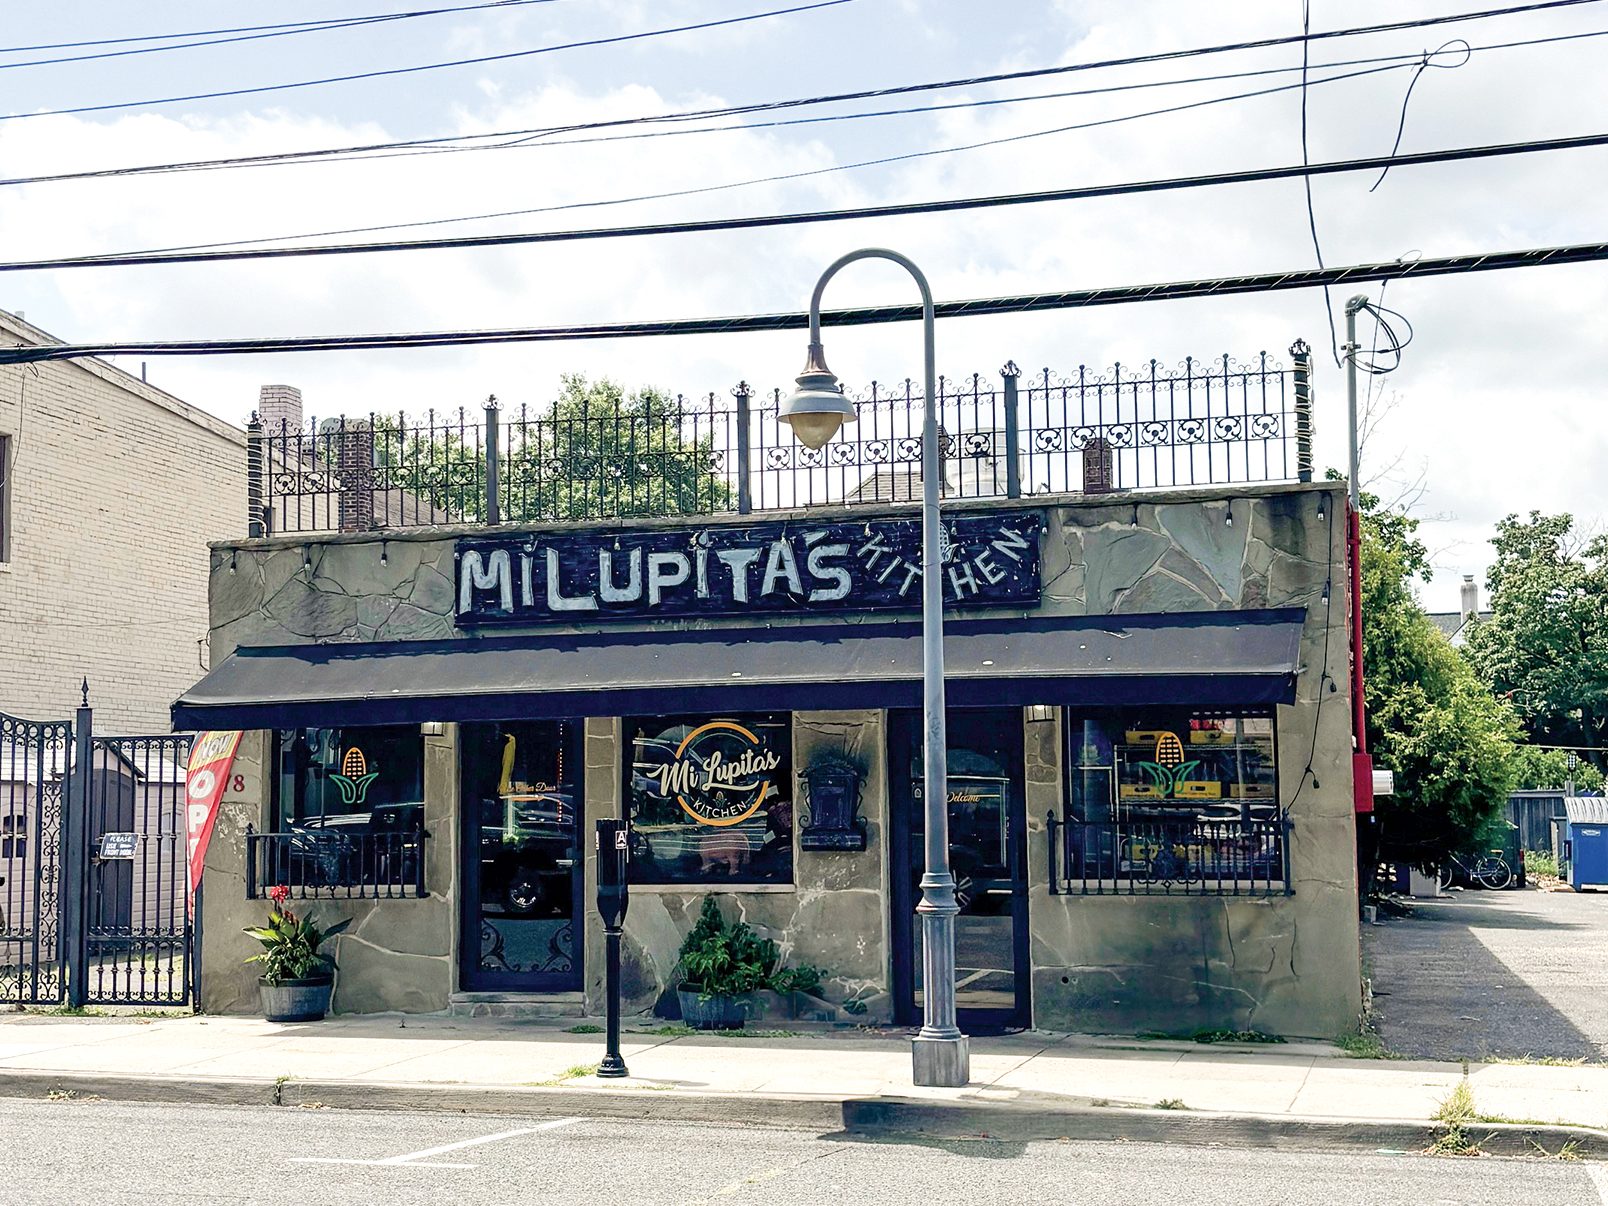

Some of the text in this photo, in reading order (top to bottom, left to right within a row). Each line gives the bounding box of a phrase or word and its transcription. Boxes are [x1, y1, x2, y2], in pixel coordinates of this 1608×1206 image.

[857, 526, 1030, 600] KITHEN
[200, 735, 231, 758] NOW
[646, 748, 780, 796] Mi Lupita's
[693, 801, 747, 818] KITCHEN
